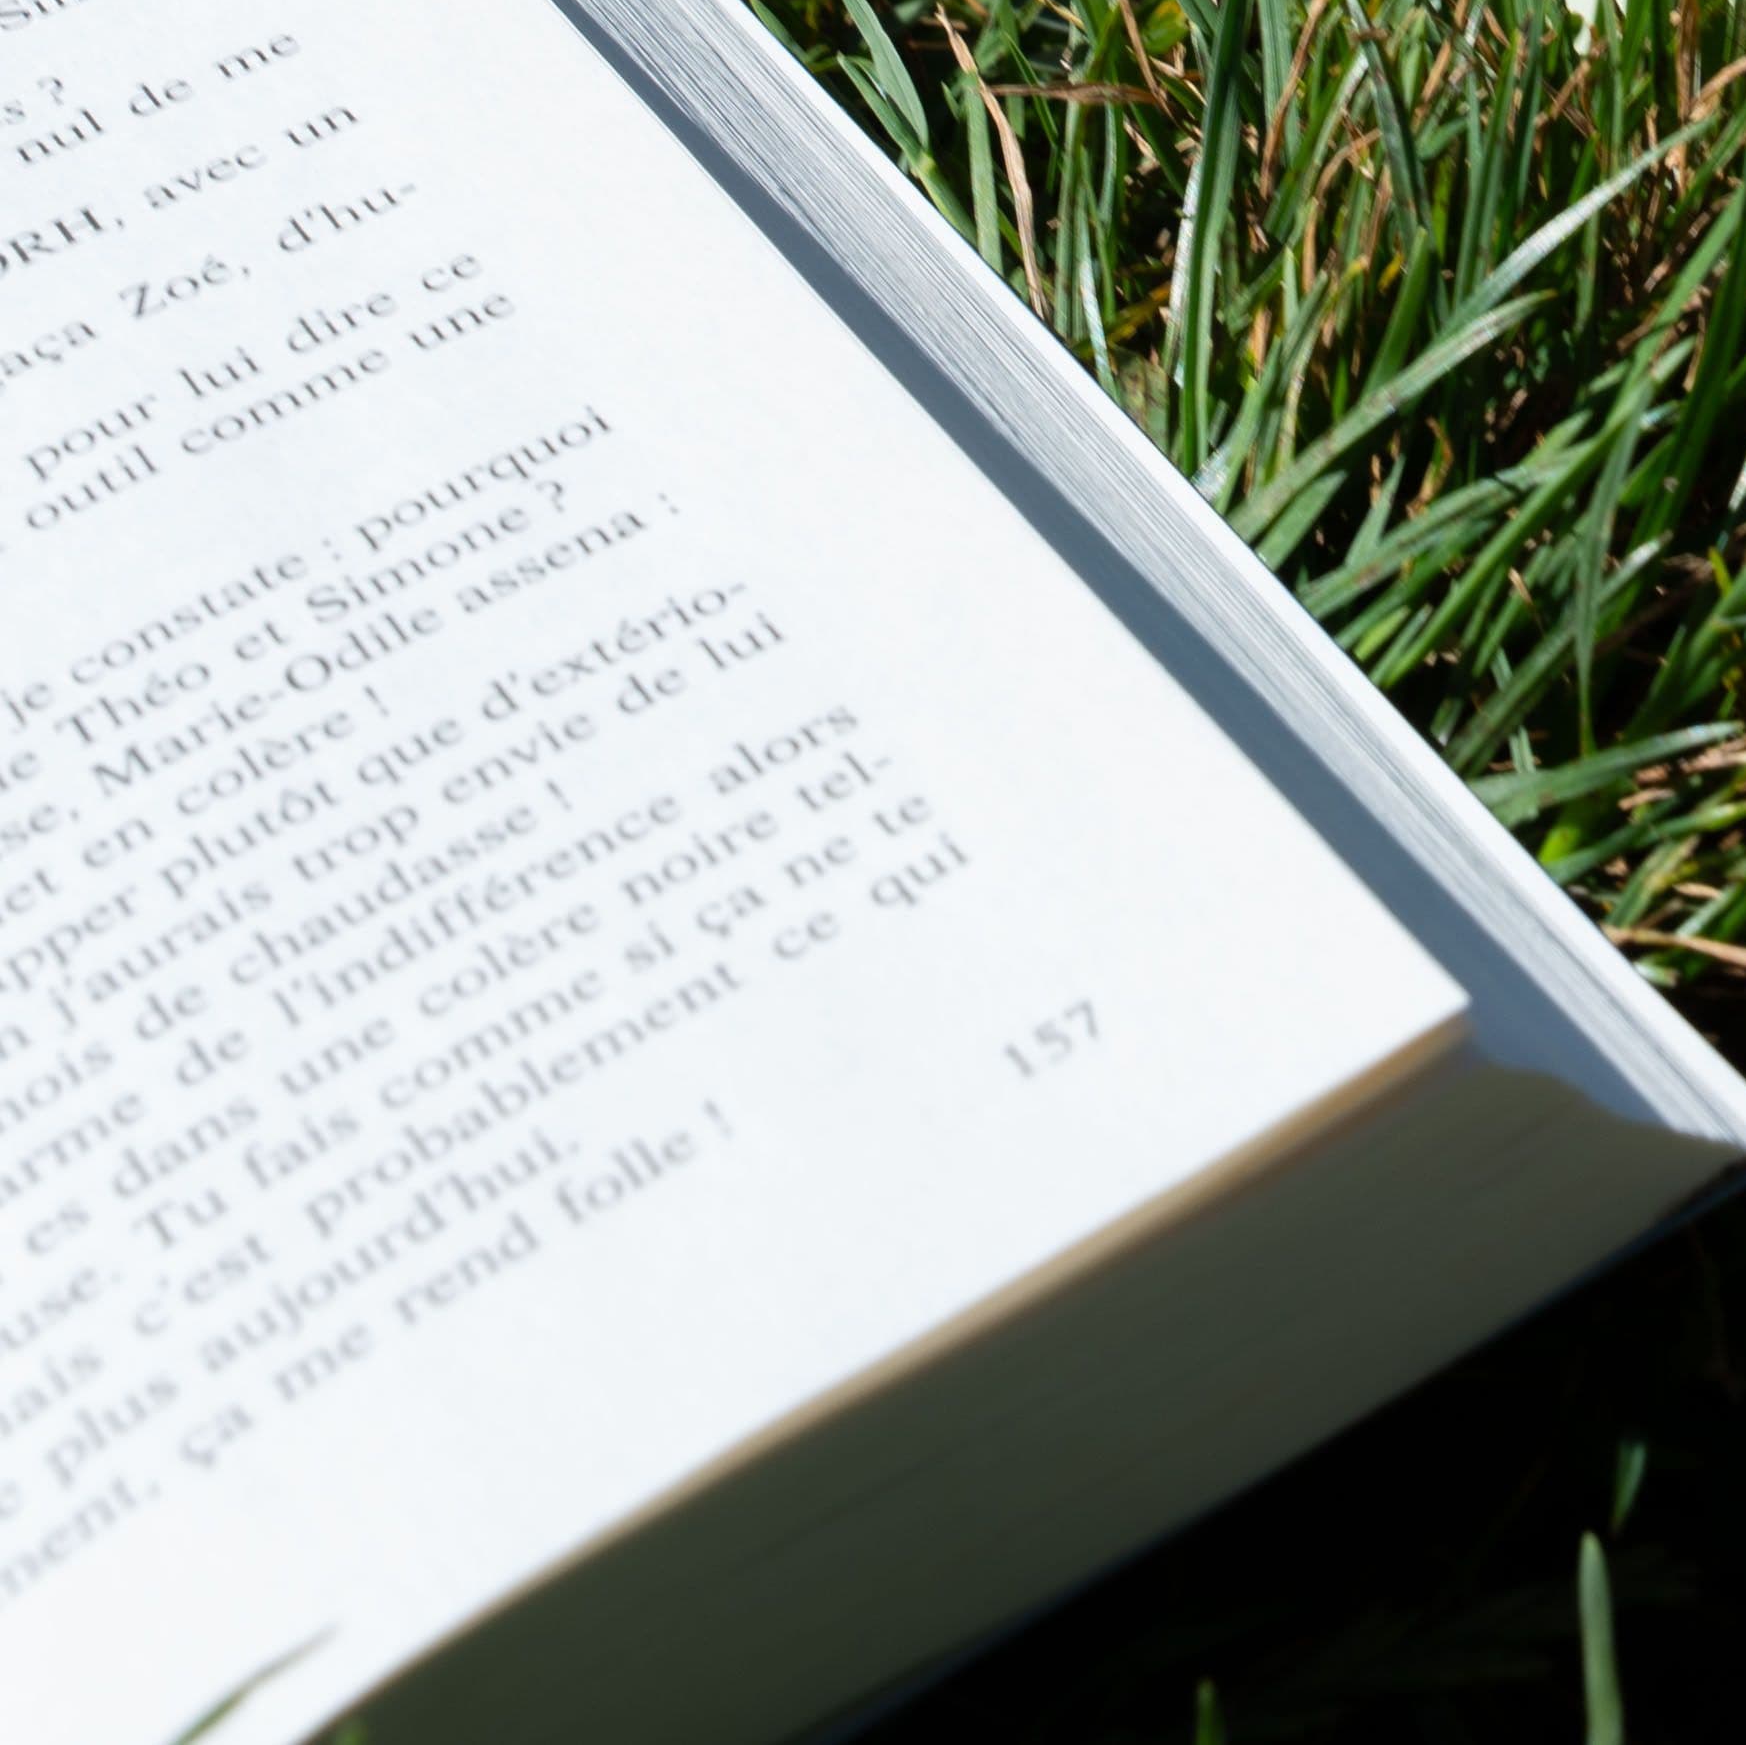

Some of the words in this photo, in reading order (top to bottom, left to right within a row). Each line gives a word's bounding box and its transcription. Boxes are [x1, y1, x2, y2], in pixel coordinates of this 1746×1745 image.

[14, 106, 107, 166] nul
[127, 78, 193, 118] de
[212, 33, 300, 81] me
[142, 144, 265, 211] avec
[282, 106, 360, 149] un
[0, 320, 100, 392] aça
[117, 253, 251, 321] Zoé,
[23, 393, 158, 485] pour
[175, 345, 263, 401] lui
[285, 292, 396, 355] dire
[420, 253, 482, 294] ce
[23, 442, 161, 531] outil
[179, 348, 389, 457] comme
[406, 294, 515, 352] une
[52, 662, 212, 747] Théo
[232, 619, 290, 663] et
[303, 507, 530, 625] Simone
[69, 554, 307, 686] constate
[353, 404, 614, 556] pourquoi
[88, 608, 441, 798] Marie-Odile
[455, 511, 649, 615] assena
[0, 885, 137, 994] pper
[157, 779, 341, 902] plutôt
[355, 718, 462, 787] que
[479, 582, 748, 723] d'extério-
[47, 881, 274, 1034] j'aurais
[290, 804, 420, 883] trop
[440, 713, 596, 806] envie
[615, 668, 685, 716] de
[695, 610, 785, 672] lui
[80, 817, 156, 870] en
[175, 710, 353, 818] colère
[133, 985, 207, 1042] de
[228, 805, 538, 987] chaudasse
[174, 1030, 246, 1088] de
[271, 795, 681, 1029] l'indifférence
[708, 705, 859, 798] alors
[111, 1096, 261, 1201] dans
[277, 1017, 396, 1098] une
[417, 903, 598, 1020] colère
[619, 810, 779, 908] noire
[794, 750, 894, 814] tel-
[132, 1188, 230, 1250] Tu
[242, 1108, 363, 1192] fais
[378, 969, 599, 1111] comme
[622, 920, 677, 974] si
[694, 885, 767, 940] ça
[781, 836, 853, 889] ne
[871, 796, 932, 838] te
[303, 961, 742, 1240] probablement
[771, 911, 838, 961] ce
[868, 832, 969, 908] qui
[1003, 998, 1100, 1080] 157
[43, 1375, 181, 1491] plus
[199, 1128, 582, 1376] aujourd'hui.
[271, 1321, 373, 1405] me
[391, 1210, 542, 1327] rend
[554, 1131, 697, 1227] folle
